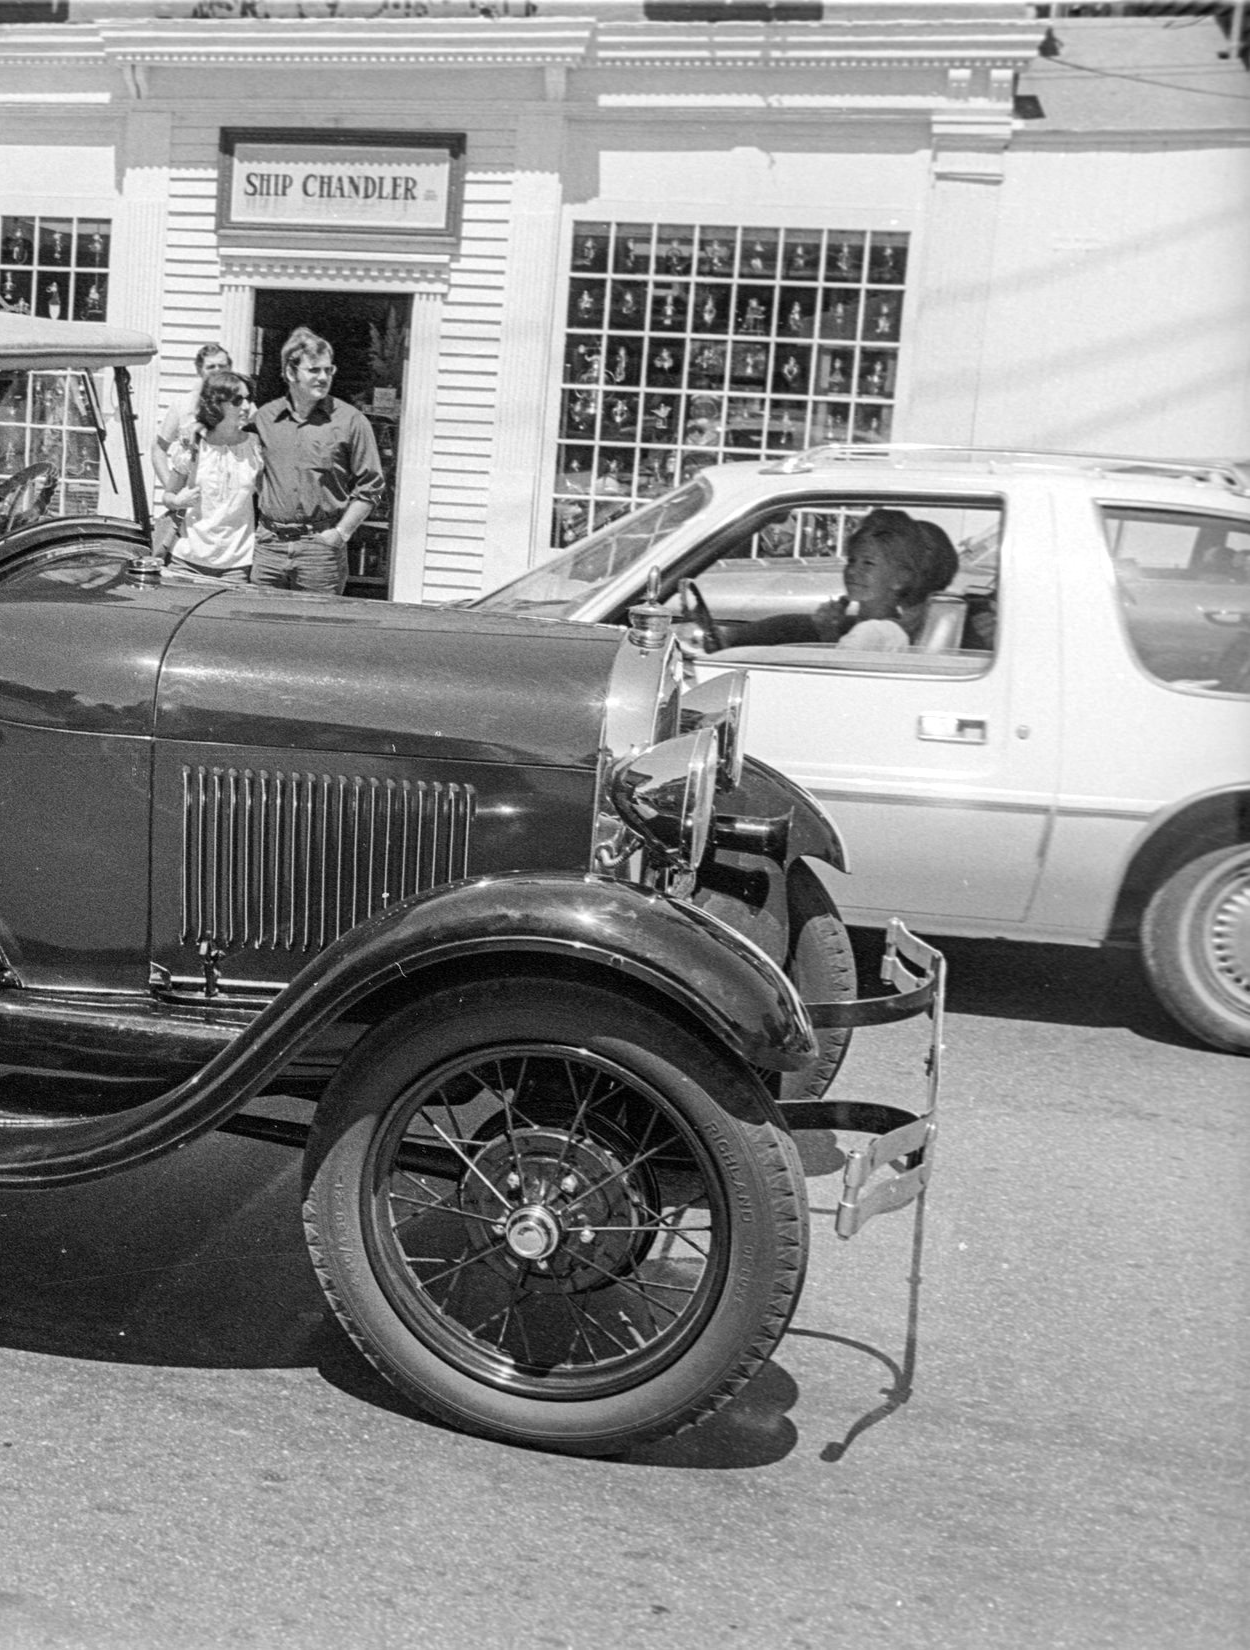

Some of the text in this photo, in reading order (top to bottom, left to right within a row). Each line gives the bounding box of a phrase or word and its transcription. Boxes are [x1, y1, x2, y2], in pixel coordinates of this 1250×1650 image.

[244, 172, 293, 198] SHIP
[302, 173, 418, 201] CHANDLER
[704, 1122, 752, 1222] RICHLAND
